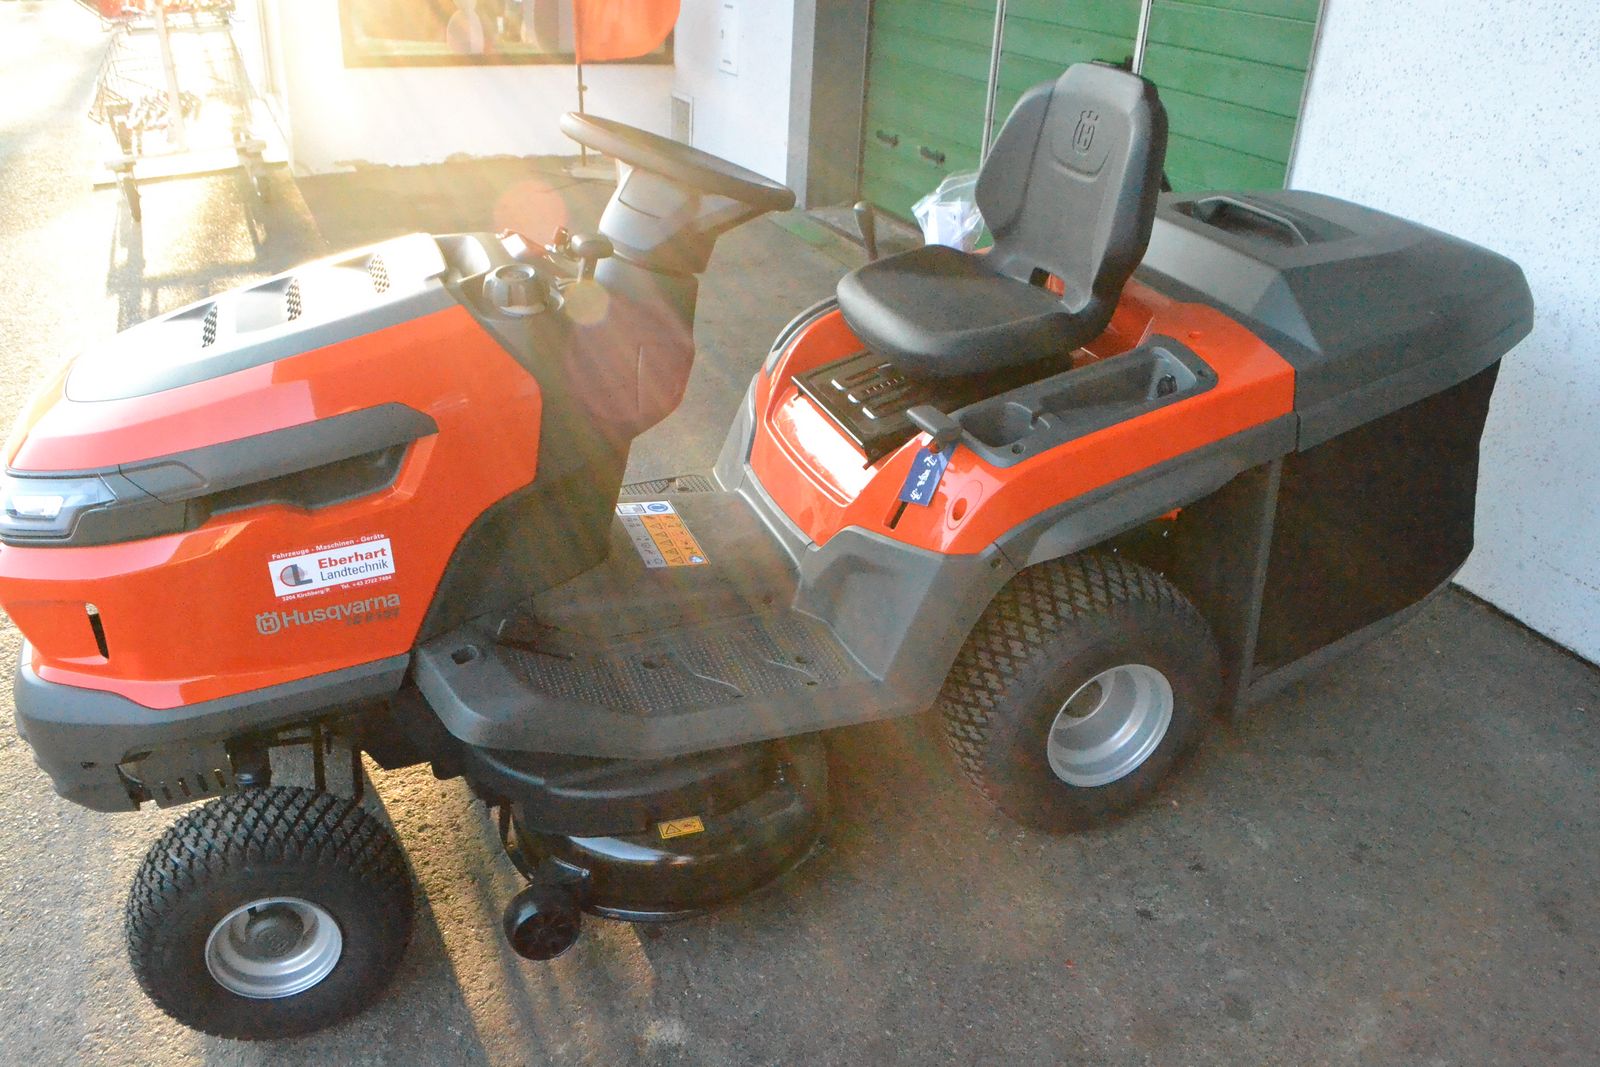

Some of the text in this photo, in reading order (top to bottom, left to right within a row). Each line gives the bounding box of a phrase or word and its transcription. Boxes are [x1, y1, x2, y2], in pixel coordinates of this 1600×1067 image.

[271, 549, 309, 560] Fahrzeuge
[315, 540, 355, 551] Maschinen
[360, 533, 385, 542] Geräte
[317, 547, 388, 569] Eberhart
[320, 559, 389, 581] Landtechnik
[282, 593, 401, 628] Husqvarna
